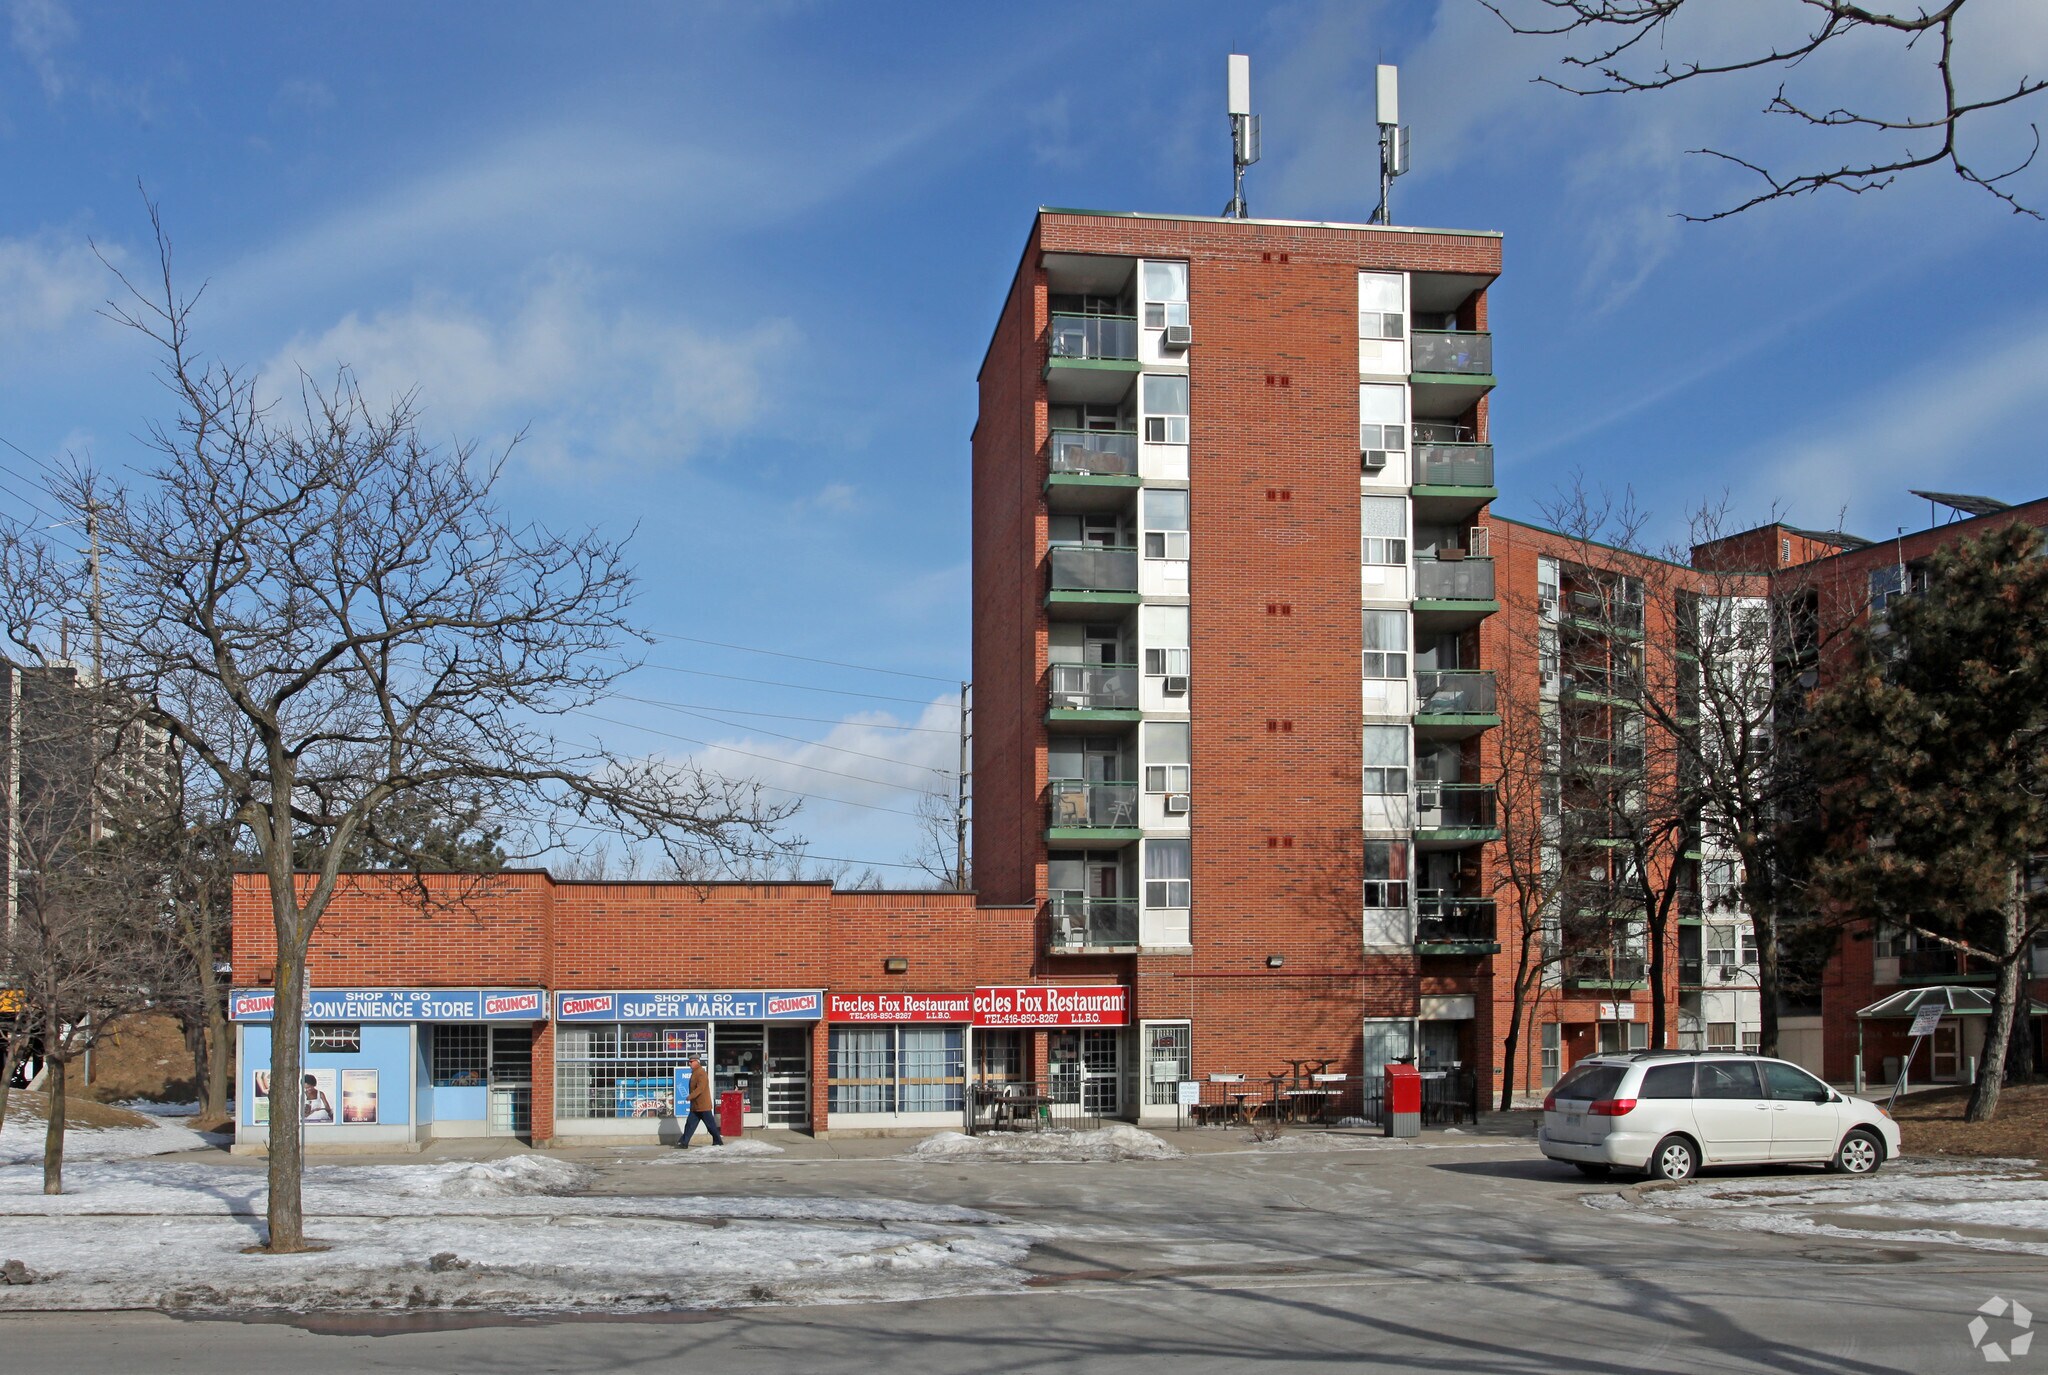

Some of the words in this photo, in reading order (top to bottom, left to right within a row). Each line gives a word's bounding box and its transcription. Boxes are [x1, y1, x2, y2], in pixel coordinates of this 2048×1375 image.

[345, 992, 384, 1001] SHOP
[410, 992, 431, 1001] GO
[486, 995, 537, 1013] CRUNCH
[654, 994, 689, 1003] SHOP
[713, 994, 733, 1002] GO
[769, 996, 816, 1013] CRUNCH
[831, 995, 875, 1012] Frecles
[878, 995, 900, 1012] Fox
[903, 995, 969, 1012] Restaurant
[1016, 989, 1043, 1012] Fox
[1046, 989, 1126, 1012] Restaurant
[304, 1001, 414, 1018] CONVENIENCE
[421, 1001, 474, 1017] STORE
[563, 997, 611, 1014] CRUNCH
[623, 1002, 679, 1017] SUPER
[686, 1002, 757, 1017] MARKET
